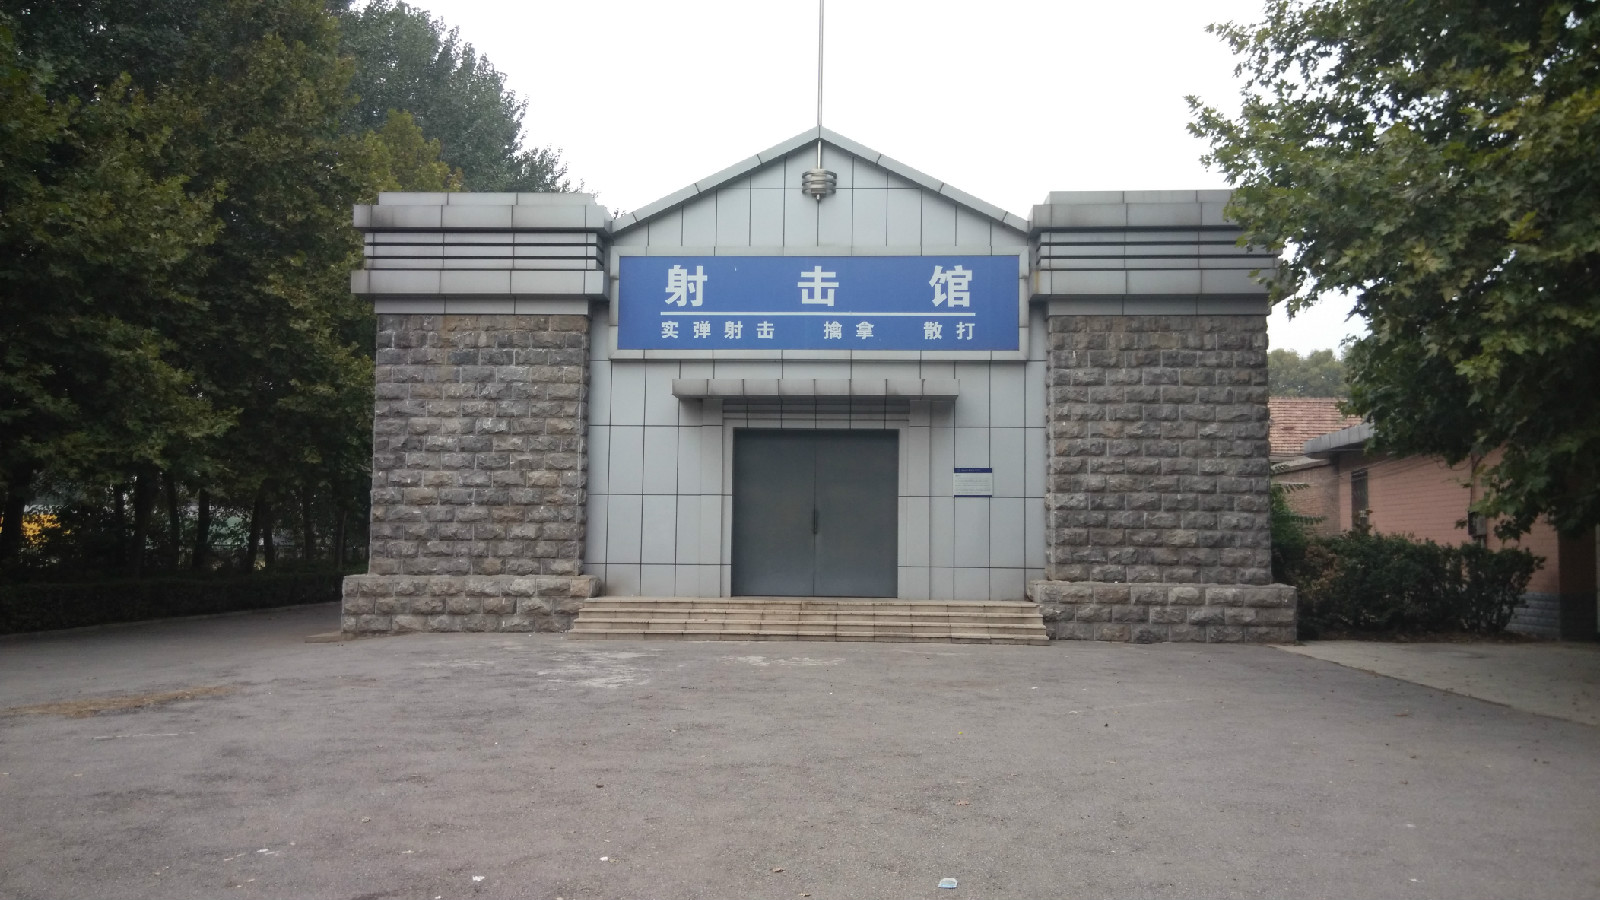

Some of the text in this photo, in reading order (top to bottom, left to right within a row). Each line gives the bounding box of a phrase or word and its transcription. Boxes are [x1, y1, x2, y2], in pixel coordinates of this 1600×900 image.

[664, 264, 973, 307] 射击馆
[661, 320, 976, 341] 实弹射击 擒拿 散打
